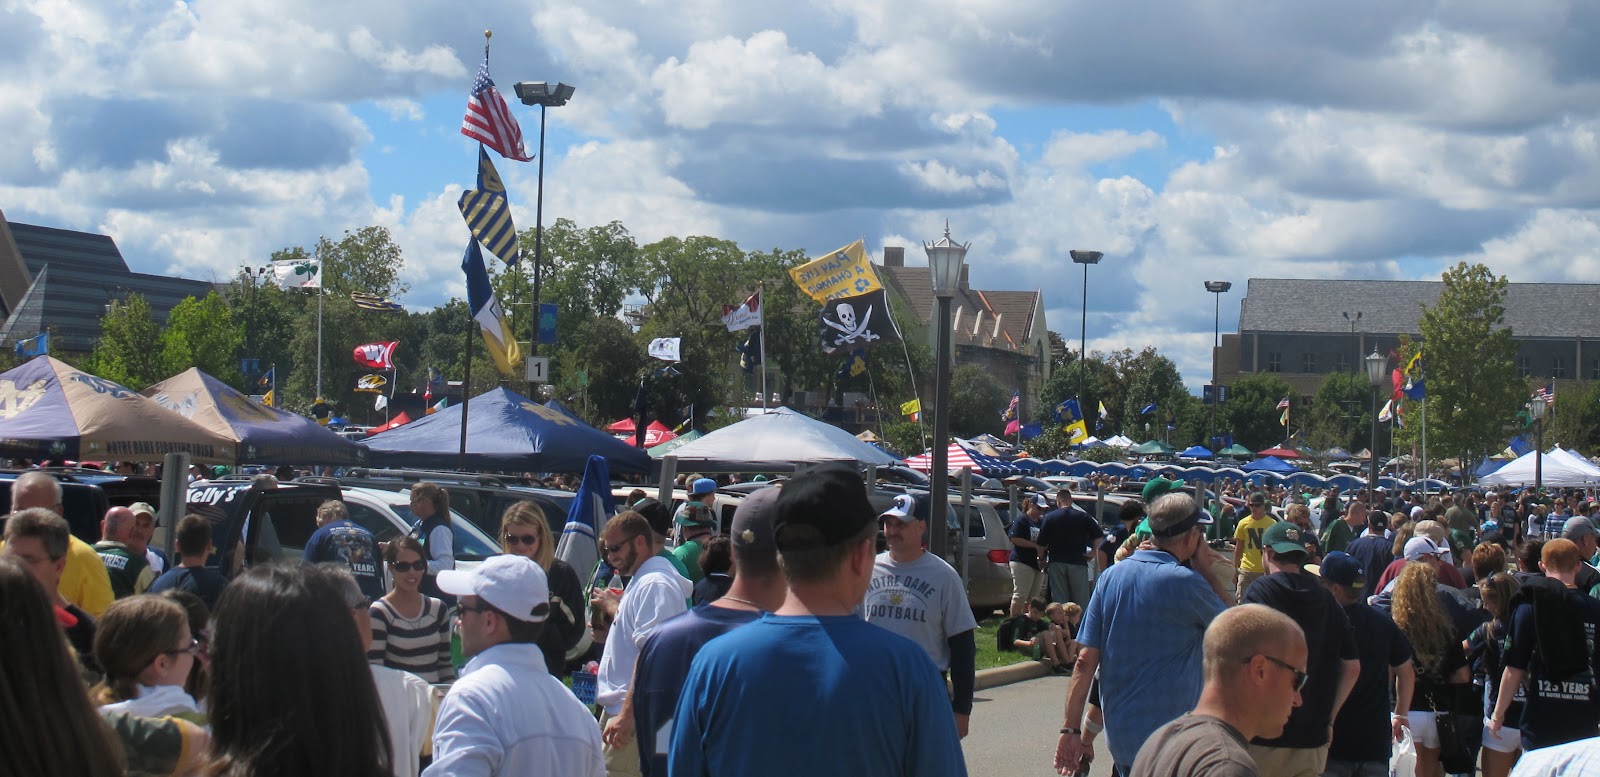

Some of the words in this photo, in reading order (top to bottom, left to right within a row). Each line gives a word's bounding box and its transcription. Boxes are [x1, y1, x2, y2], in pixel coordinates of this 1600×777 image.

[534, 361, 541, 377] 1
[106, 441, 131, 455] NOTRE
[132, 441, 155, 455] DAME
[192, 443, 215, 458] IRISH
[352, 563, 375, 573] YEARS
[867, 575, 901, 594] NOTRE
[903, 576, 936, 598] DAME
[866, 604, 927, 623] FOOTBALL
[1561, 681, 1590, 695] YEARS
